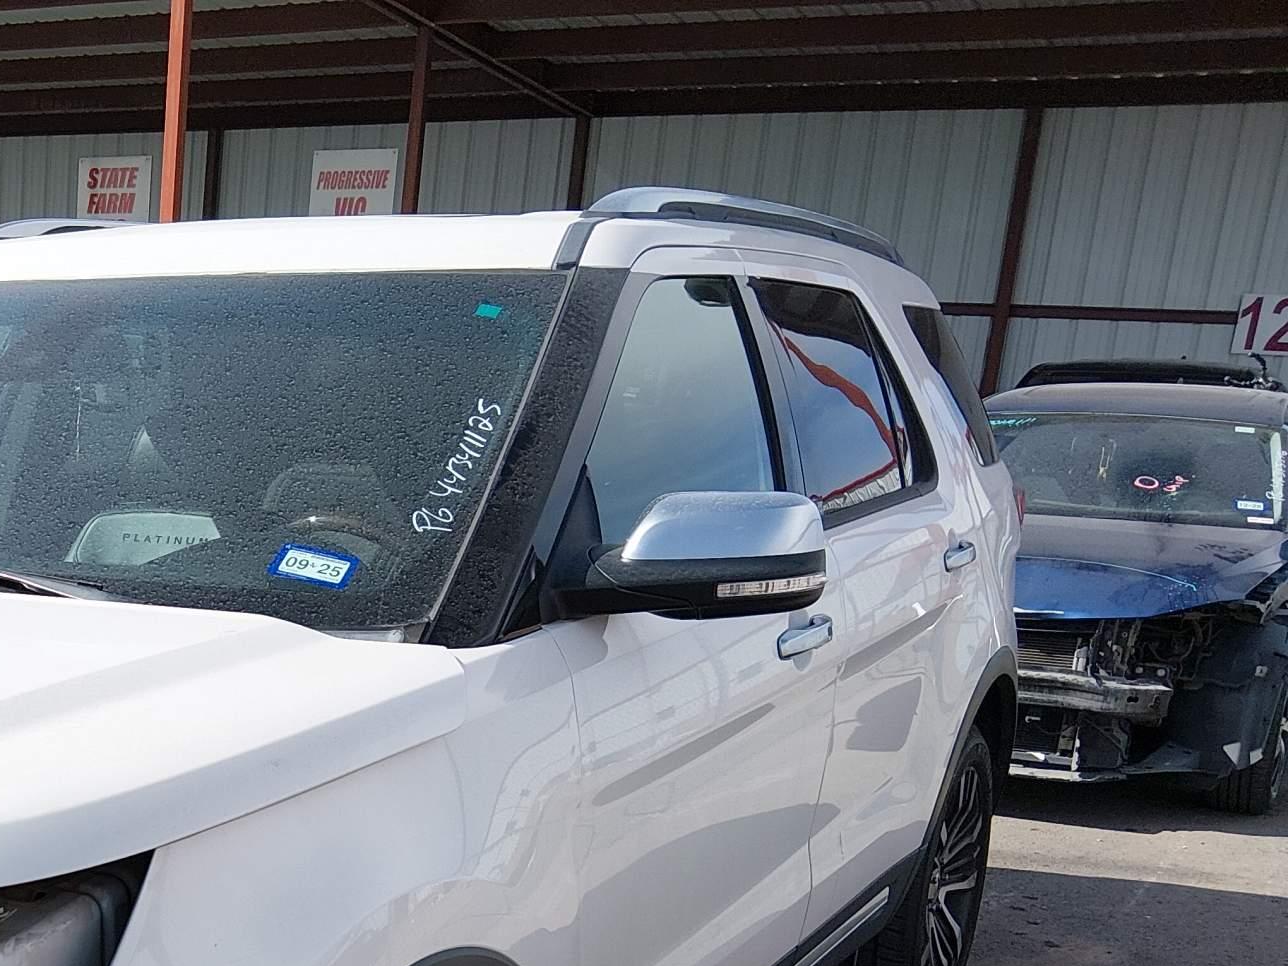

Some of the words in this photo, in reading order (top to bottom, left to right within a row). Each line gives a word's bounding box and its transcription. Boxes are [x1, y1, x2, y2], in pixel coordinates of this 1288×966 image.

[86, 167, 139, 189] STATE
[316, 169, 390, 191] PROGRESSIVE
[86, 192, 136, 214] FARM
[317, 563, 343, 577] 25
